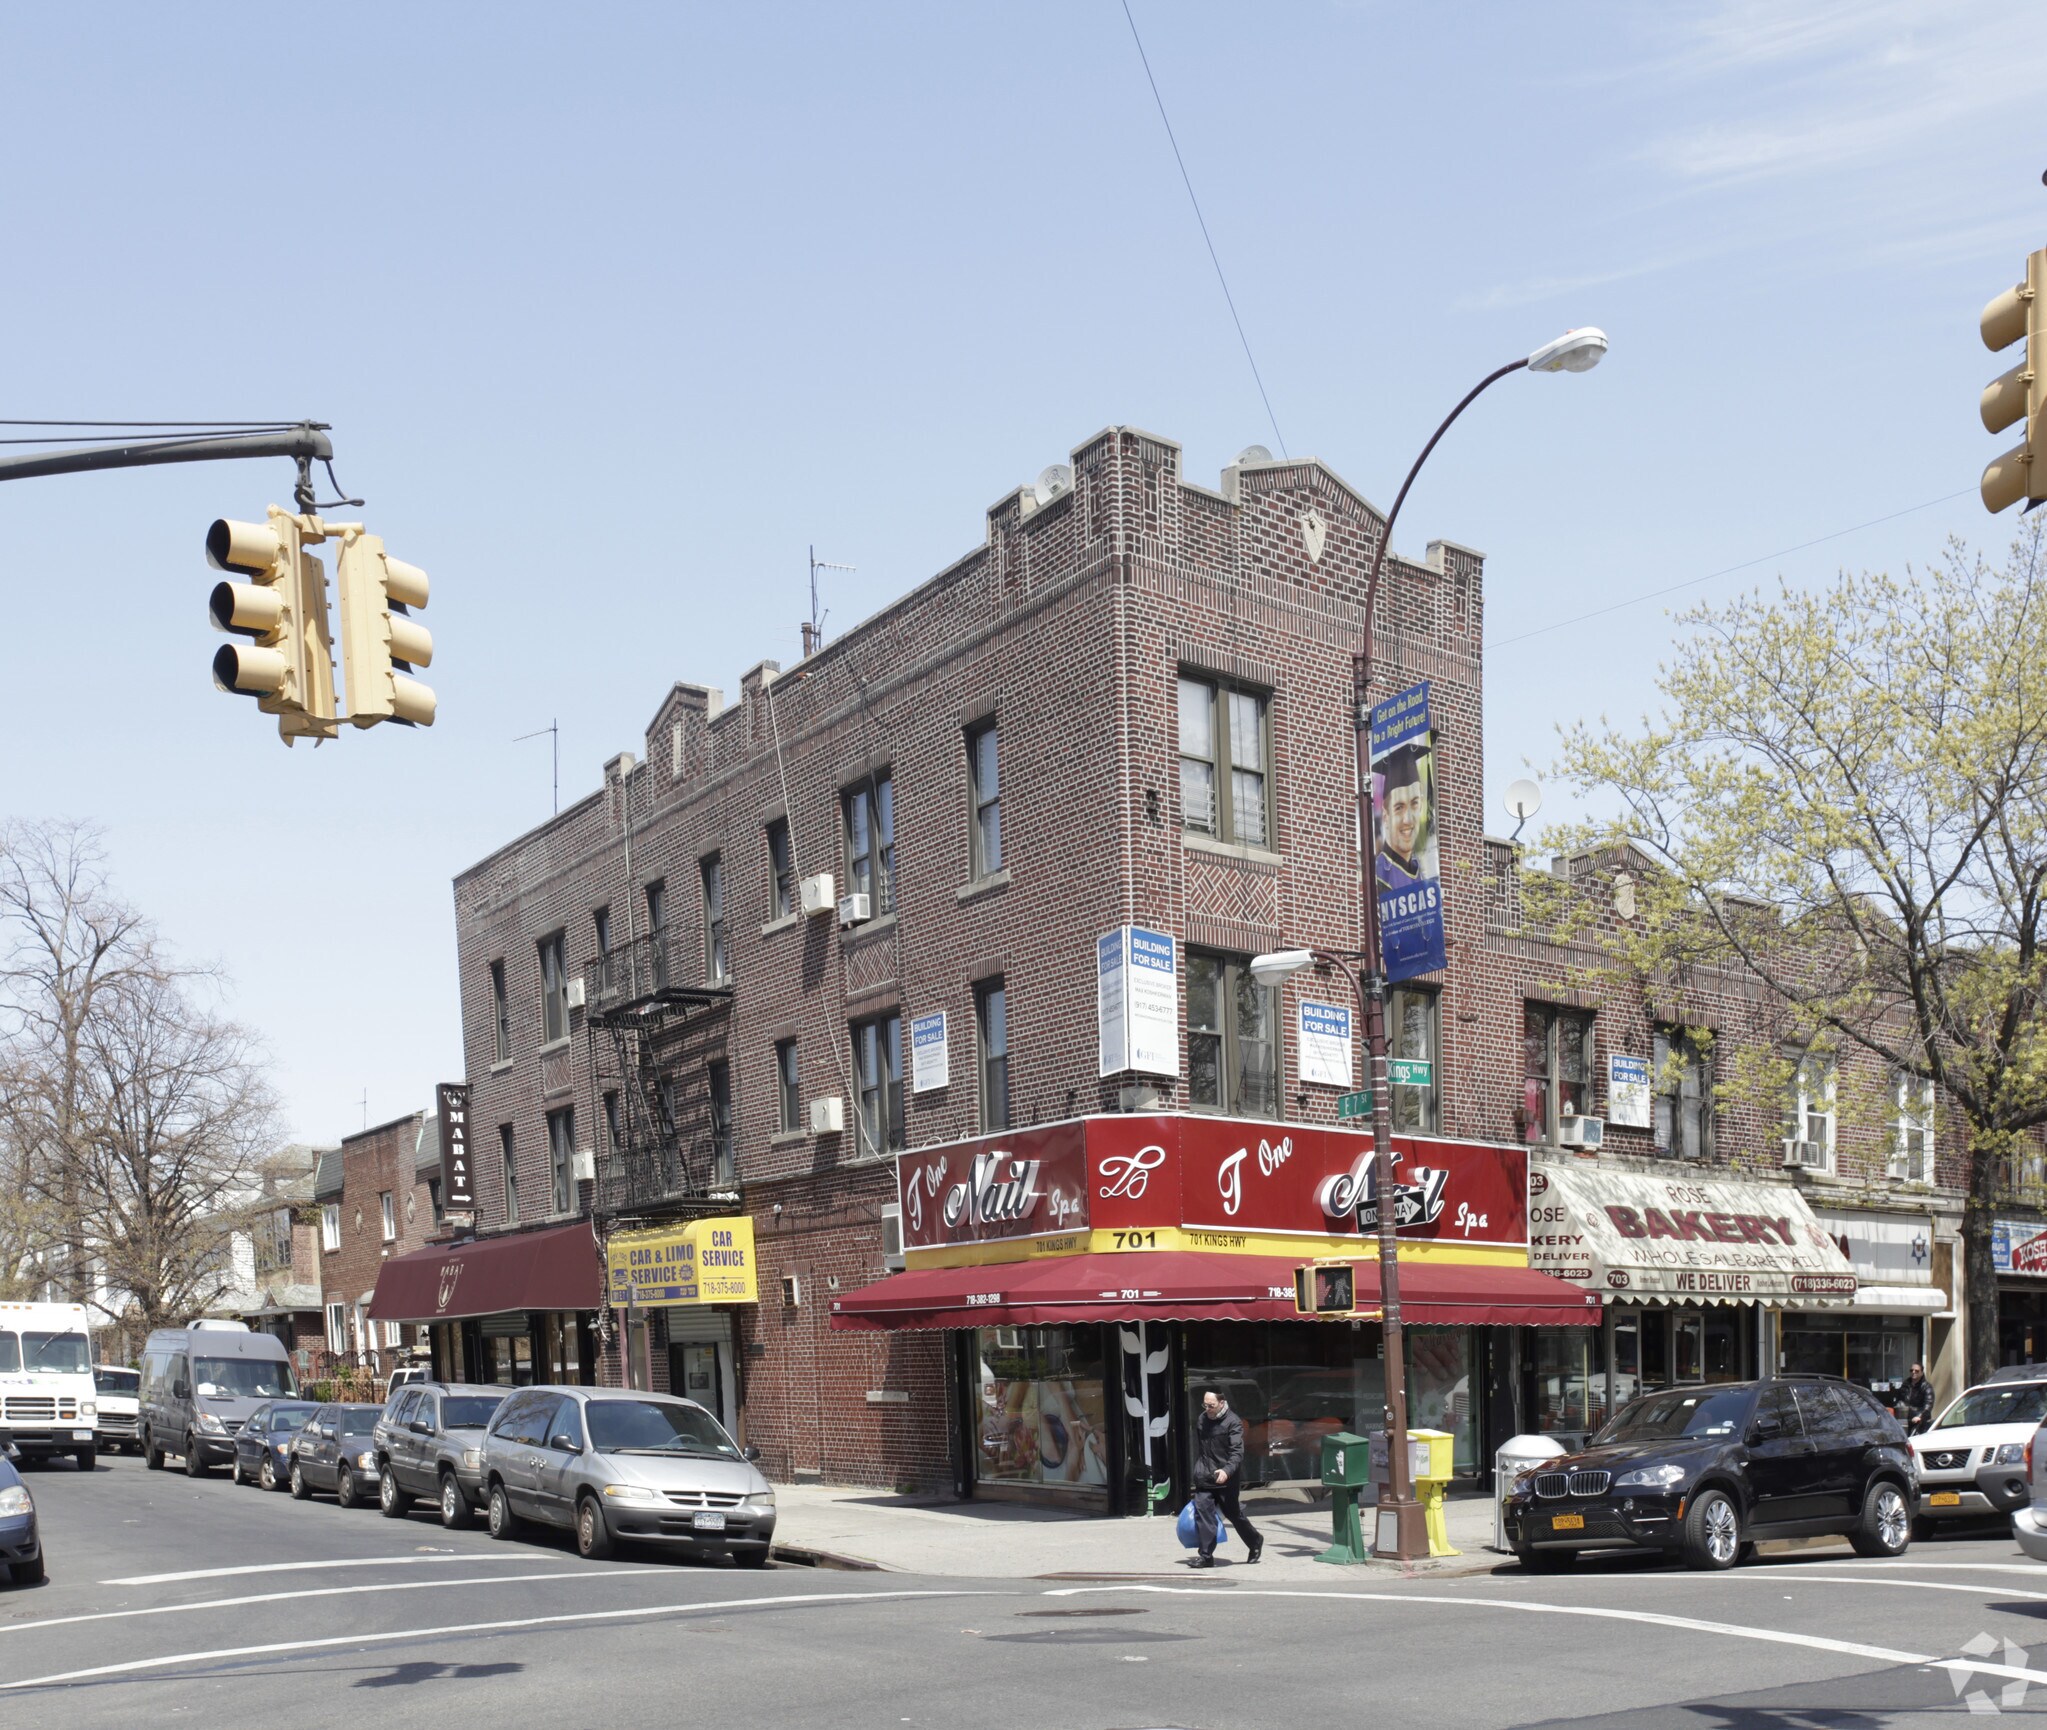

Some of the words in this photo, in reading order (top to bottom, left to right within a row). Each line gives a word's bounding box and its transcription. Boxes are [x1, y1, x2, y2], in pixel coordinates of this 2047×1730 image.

[1377, 708, 1387, 723] Get
[1388, 706, 1396, 717] on
[1397, 699, 1406, 713] the
[1408, 688, 1422, 708] Road
[1373, 733, 1380, 744] to
[1381, 731, 1386, 741] a
[1387, 720, 1403, 738] Bright
[1405, 708, 1426, 729] Future!
[1381, 887, 1437, 922] NYSCAS
[1101, 940, 1122, 957] BUILDING
[1133, 938, 1171, 956] BUILDING
[1101, 961, 1111, 973] FOR
[1111, 955, 1122, 969] SALE
[1133, 953, 1150, 966] FOR
[1151, 957, 1171, 971] SALE
[1304, 1006, 1346, 1022] BUILDING
[914, 1018, 941, 1032] BUILDING
[1304, 1021, 1323, 1032] FOR
[1325, 1025, 1347, 1036] SALE
[915, 1036, 927, 1045] FOR
[928, 1031, 943, 1041] SALE
[1387, 1062, 1411, 1082] Kings
[1412, 1064, 1428, 1077] Hwy
[1613, 1059, 1645, 1071] BUILDING
[1614, 1071, 1629, 1080] FOR
[1629, 1074, 1646, 1083] SALE
[1344, 1097, 1350, 1115] E
[1353, 1095, 1359, 1113] 7
[1361, 1093, 1367, 1103] St
[450, 1111, 466, 1187] MABAT
[1258, 1136, 1293, 1176] One
[926, 1155, 948, 1197] One
[1530, 1175, 1544, 1187] 03
[944, 1151, 1041, 1227] Nail
[1049, 1189, 1080, 1225] Spa
[1318, 1150, 1449, 1223] Nl
[1455, 1201, 1489, 1237] Spa
[1666, 1186, 1712, 1204] ROSE
[1365, 1207, 1378, 1222] ON
[1394, 1202, 1414, 1217] WAY
[1530, 1207, 1564, 1223] OSE
[1604, 1204, 1797, 1246] BAKERY
[712, 1231, 733, 1247] CAR
[1036, 1241, 1046, 1253] 701
[1046, 1238, 1064, 1251] KINGS
[1064, 1237, 1078, 1249] HWY
[1113, 1232, 1156, 1249] 701
[1190, 1233, 1203, 1246] 701
[1204, 1234, 1228, 1247] KINGS
[1229, 1235, 1247, 1248] HWY
[1531, 1235, 1584, 1246] KERY
[630, 1248, 652, 1266] CAR
[655, 1251, 663, 1263] &
[666, 1244, 694, 1262] LIMO
[702, 1250, 745, 1266] SERVICE
[1534, 1252, 1590, 1261] DELIVER
[631, 1266, 677, 1284] SERVICE
[1539, 1269, 1589, 1277] 336-6023
[1609, 1274, 1628, 1285] 703
[703, 1282, 746, 1294] 718-375-8000
[1676, 1273, 1696, 1290] WE
[1699, 1273, 1751, 1291] DELIVER
[1793, 1276, 1855, 1290] (718)336-6023
[966, 1293, 1001, 1305] 718-382-1298
[1121, 1289, 1140, 1299] 701
[1585, 1296, 1596, 1304] 701
[833, 1302, 841, 1311] 701
